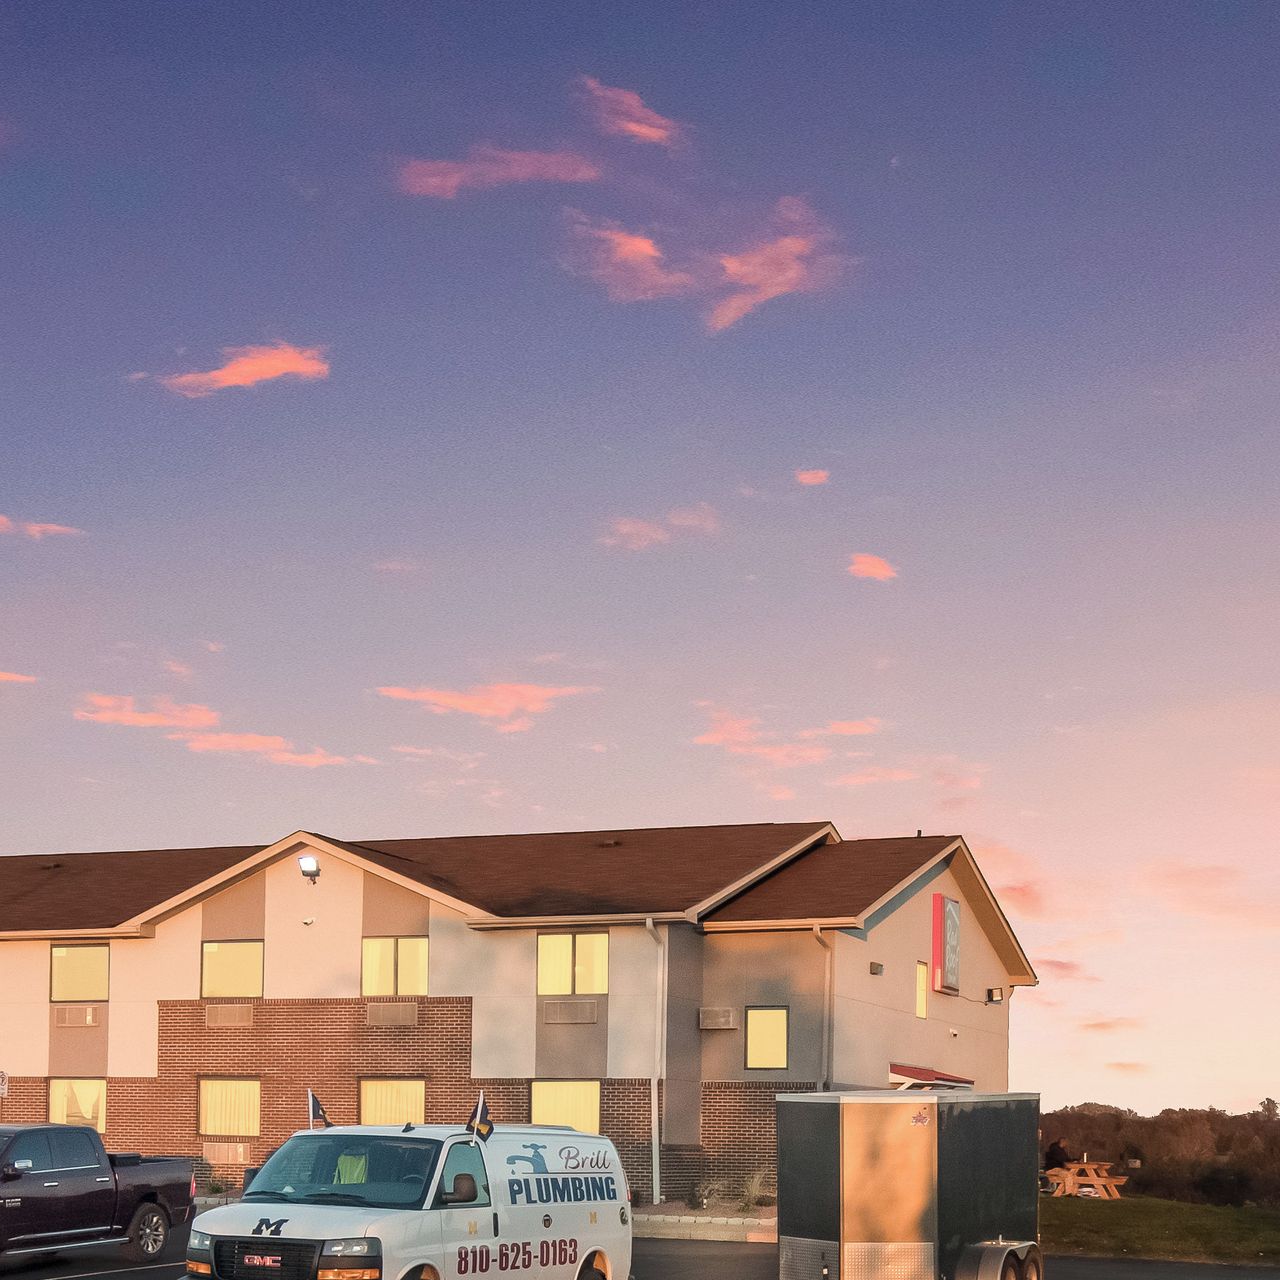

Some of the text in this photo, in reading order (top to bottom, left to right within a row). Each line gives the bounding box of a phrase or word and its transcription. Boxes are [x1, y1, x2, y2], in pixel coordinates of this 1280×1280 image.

[558, 1145, 612, 1170] Brill
[508, 1176, 618, 1205] PLUMBING
[251, 1218, 290, 1236] M
[243, 1255, 282, 1268] GMC
[457, 1238, 579, 1275] 810-625-0163
